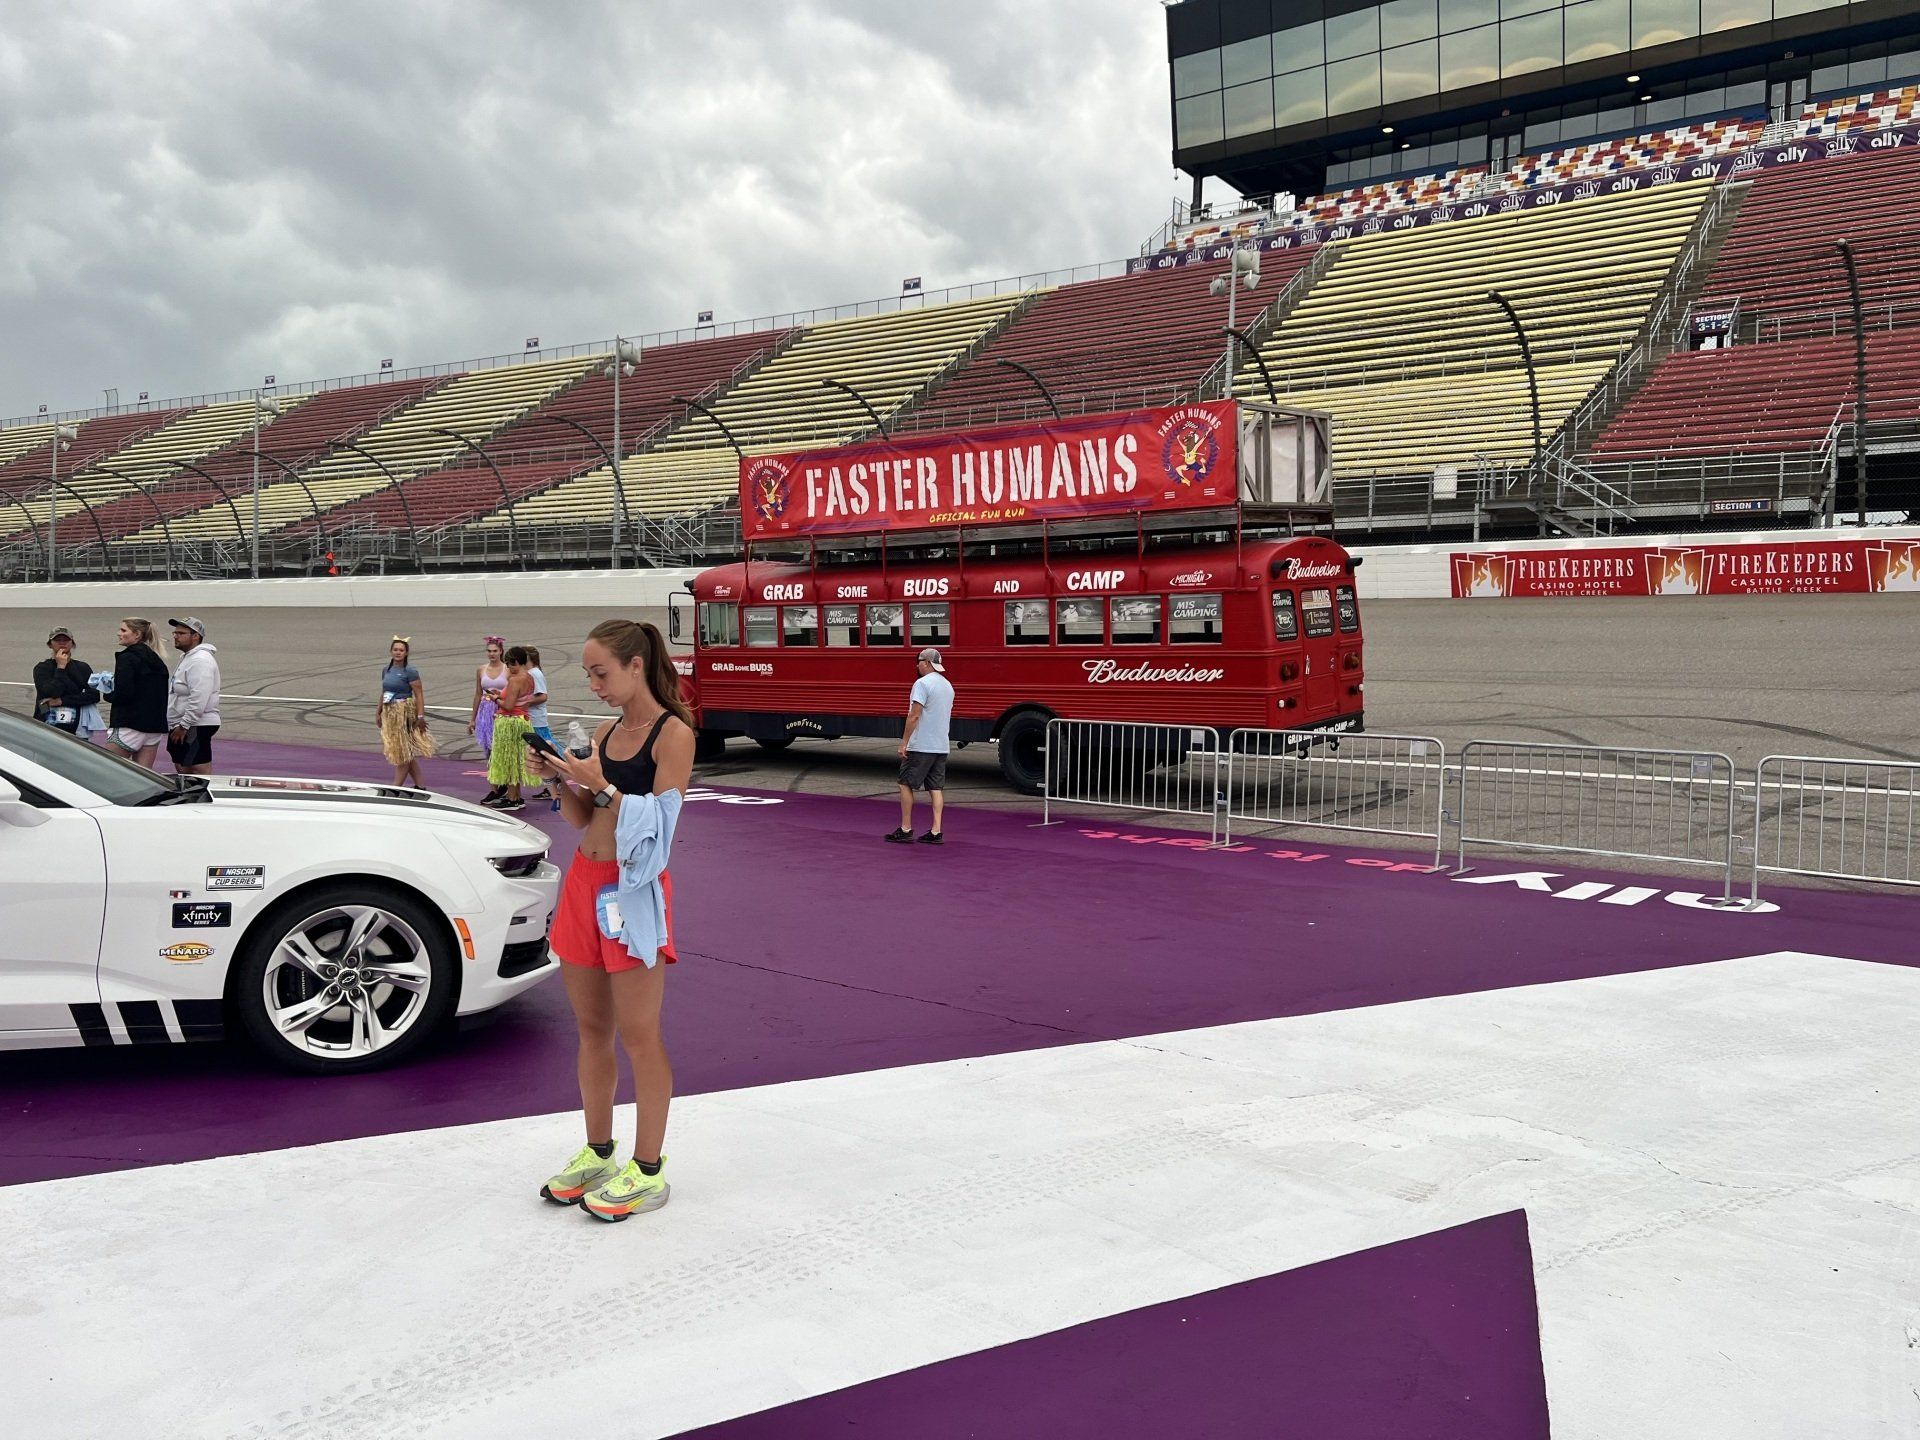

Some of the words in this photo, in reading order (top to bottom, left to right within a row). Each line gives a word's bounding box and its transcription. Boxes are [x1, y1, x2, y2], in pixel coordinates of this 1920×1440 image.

[1132, 256, 1151, 270] ally
[1158, 255, 1178, 269] ally
[1186, 249, 1205, 263] ally
[1213, 246, 1233, 260] ally
[1270, 235, 1291, 249] ally
[1300, 229, 1321, 243] ally
[1330, 225, 1353, 239] ally
[1362, 217, 1385, 232] ally
[1393, 214, 1418, 229] ally
[1431, 206, 1455, 221] ally
[1464, 203, 1489, 217] ally
[1501, 194, 1525, 209] ally
[1536, 190, 1562, 205] ally
[1574, 181, 1600, 197] ally
[1611, 176, 1640, 192] ally
[1651, 167, 1680, 183] ally
[1691, 162, 1721, 178] ally
[1734, 151, 1764, 168] ally
[1776, 147, 1808, 163] ally
[1826, 136, 1858, 152] ally
[1871, 131, 1904, 148] ally
[1158, 410, 1185, 437] FASTER
[1187, 408, 1222, 430] HUMANS
[747, 459, 764, 480] FASTER
[765, 458, 790, 477] HUMANS
[805, 457, 939, 518] FASTER
[952, 433, 1138, 508] HUMANS
[1714, 502, 1752, 511] SECTION
[1756, 501, 1761, 509] 1
[929, 511, 976, 523] OFFICIAL
[981, 509, 1001, 520] FUN
[1004, 507, 1025, 518] RUN
[1285, 557, 1341, 580] Budweiser
[1175, 573, 1205, 584] MICHIGAN
[1731, 578, 1783, 587] CASINO
[1795, 577, 1839, 586] HOTEL
[763, 583, 804, 600] GRAB
[837, 586, 868, 598] SOME
[903, 578, 949, 596] BUDS
[993, 580, 1020, 593] AND
[1066, 570, 1125, 590] CAMP
[1530, 581, 1574, 590] CASINO
[1584, 580, 1622, 590] HOTEL
[1176, 601, 1195, 610] MIS
[1173, 607, 1218, 618] CAMPING
[826, 616, 858, 624] CAMPING
[711, 662, 735, 671] GRAB
[749, 663, 773, 672] BUDS
[1081, 659, 1224, 683] Budweiser
[786, 718, 823, 731] GOODYEAR
[225, 867, 257, 876] NASCAR
[214, 878, 230, 886] CUP
[230, 877, 256, 885] SERIES
[1450, 871, 1781, 913] ally
[182, 910, 222, 923] xfinity
[159, 948, 215, 957] MENARDS
